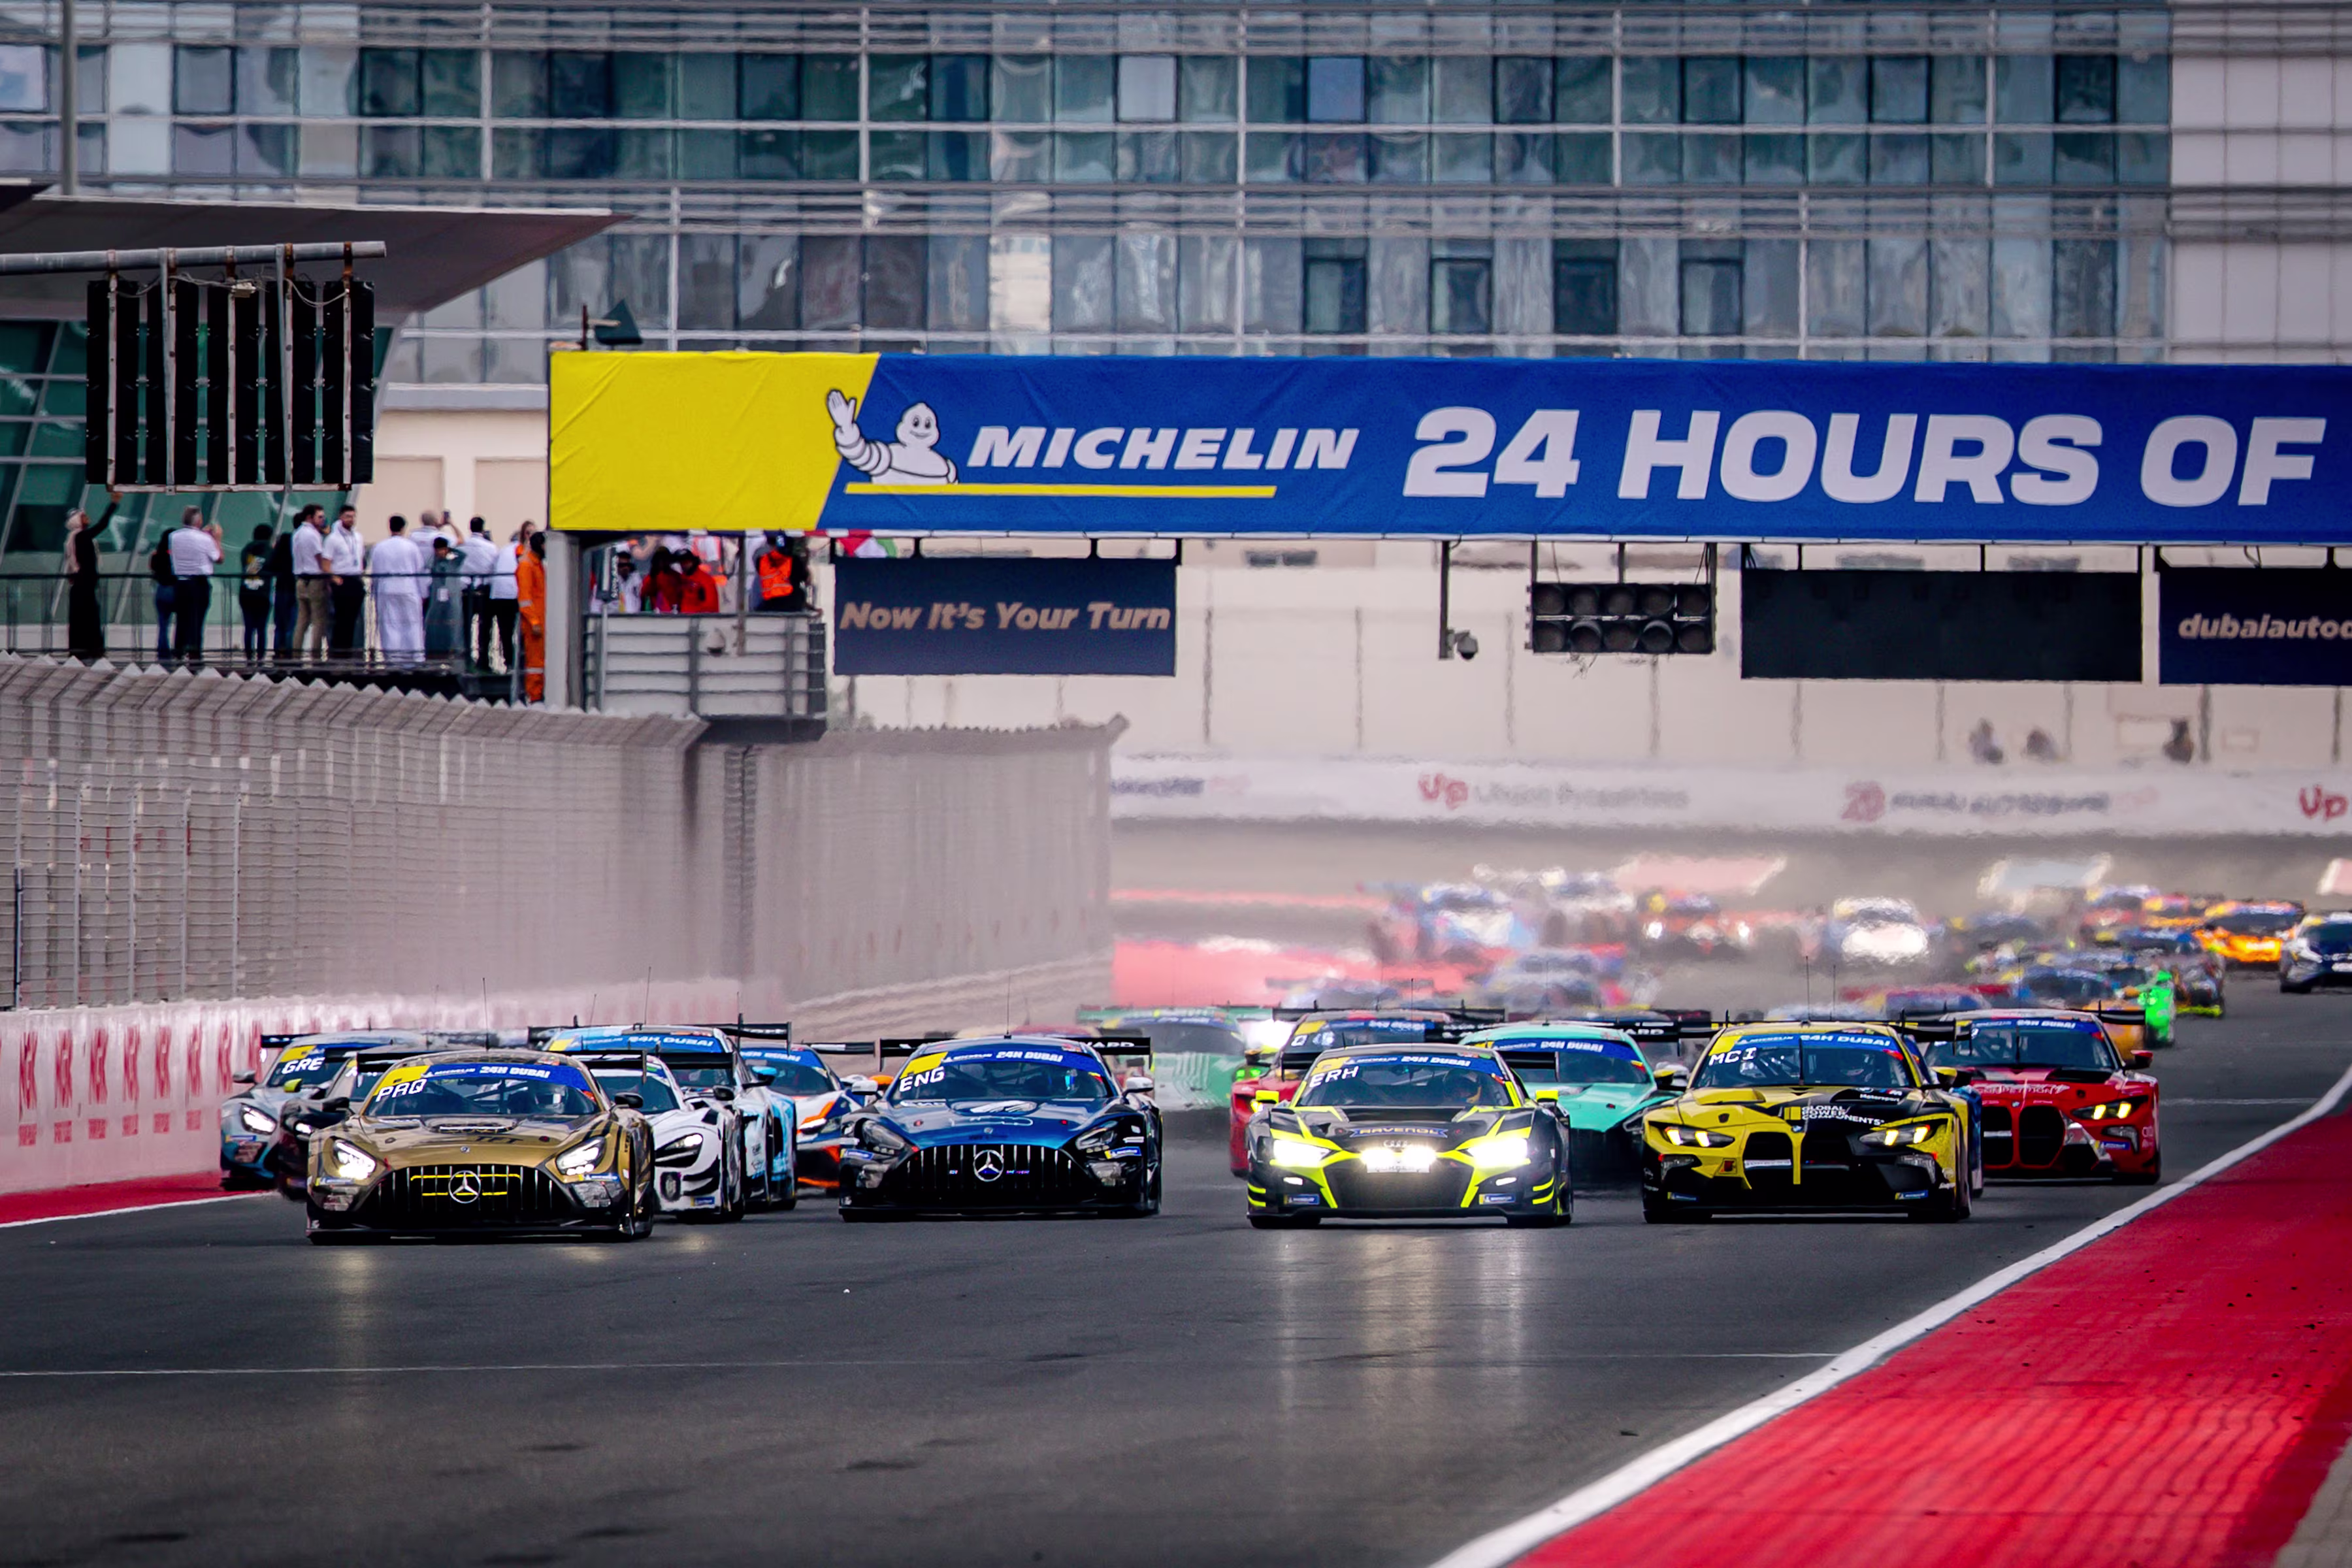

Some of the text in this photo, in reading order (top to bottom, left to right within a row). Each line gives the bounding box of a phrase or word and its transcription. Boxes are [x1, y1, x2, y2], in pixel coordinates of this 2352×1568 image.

[967, 405, 2327, 507] MICHELIN 24 HOURS OF
[840, 601, 921, 630] Now
[996, 601, 1080, 630] Your
[1087, 600, 1171, 630] Turn
[1837, 1036, 1891, 1047] DUBAI
[282, 1056, 326, 1075] GRE
[1024, 1051, 1064, 1063] DUBAI
[1429, 1056, 1471, 1068] DUBAI
[1708, 1047, 1757, 1066] MCI
[479, 1066, 509, 1075] 24H
[509, 1066, 551, 1079] DUBAI
[898, 1066, 947, 1093] ENG
[1309, 1065, 1360, 1088] ERH
